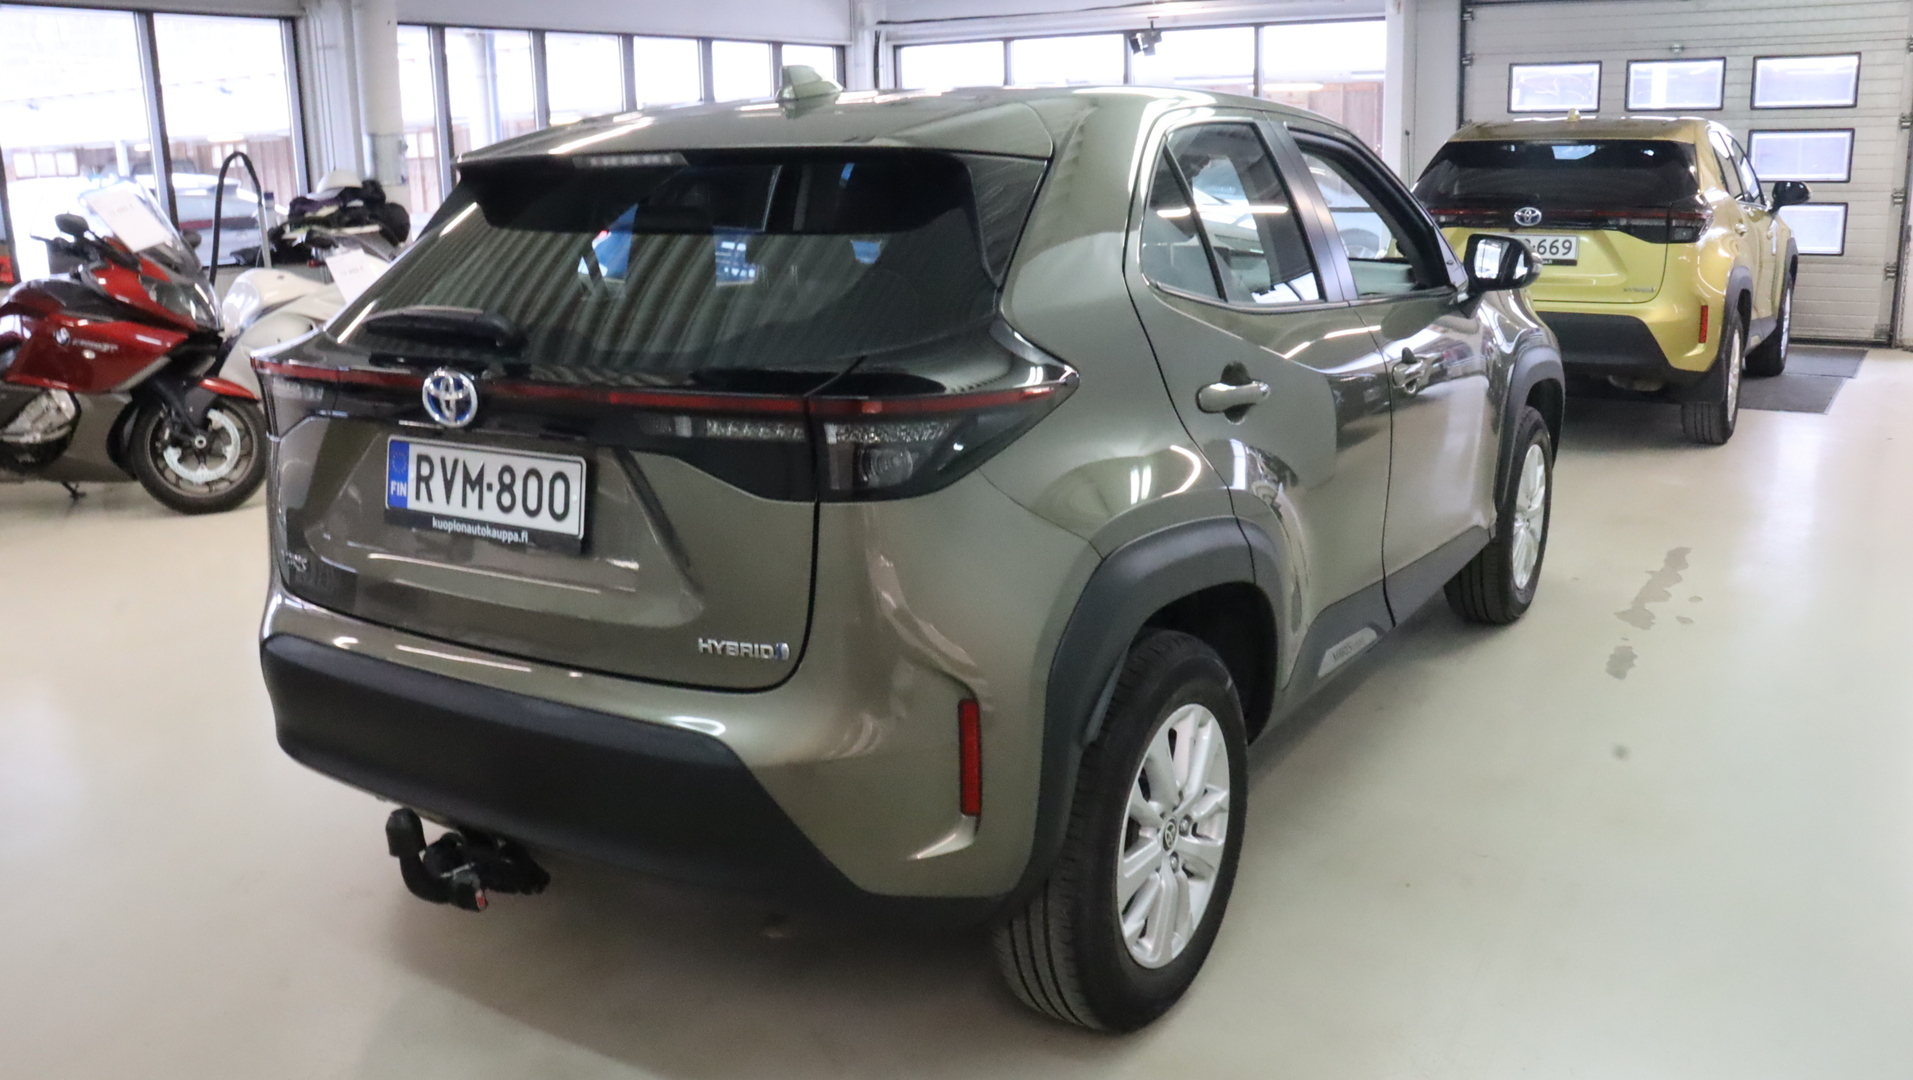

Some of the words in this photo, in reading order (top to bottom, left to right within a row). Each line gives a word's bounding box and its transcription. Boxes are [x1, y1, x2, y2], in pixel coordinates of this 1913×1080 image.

[1524, 238, 1573, 256] -669
[390, 481, 408, 497] FIN
[415, 453, 571, 523] RVM-800
[432, 516, 529, 544] kuopionautokauppa.fi
[698, 637, 775, 660] HYBRID
